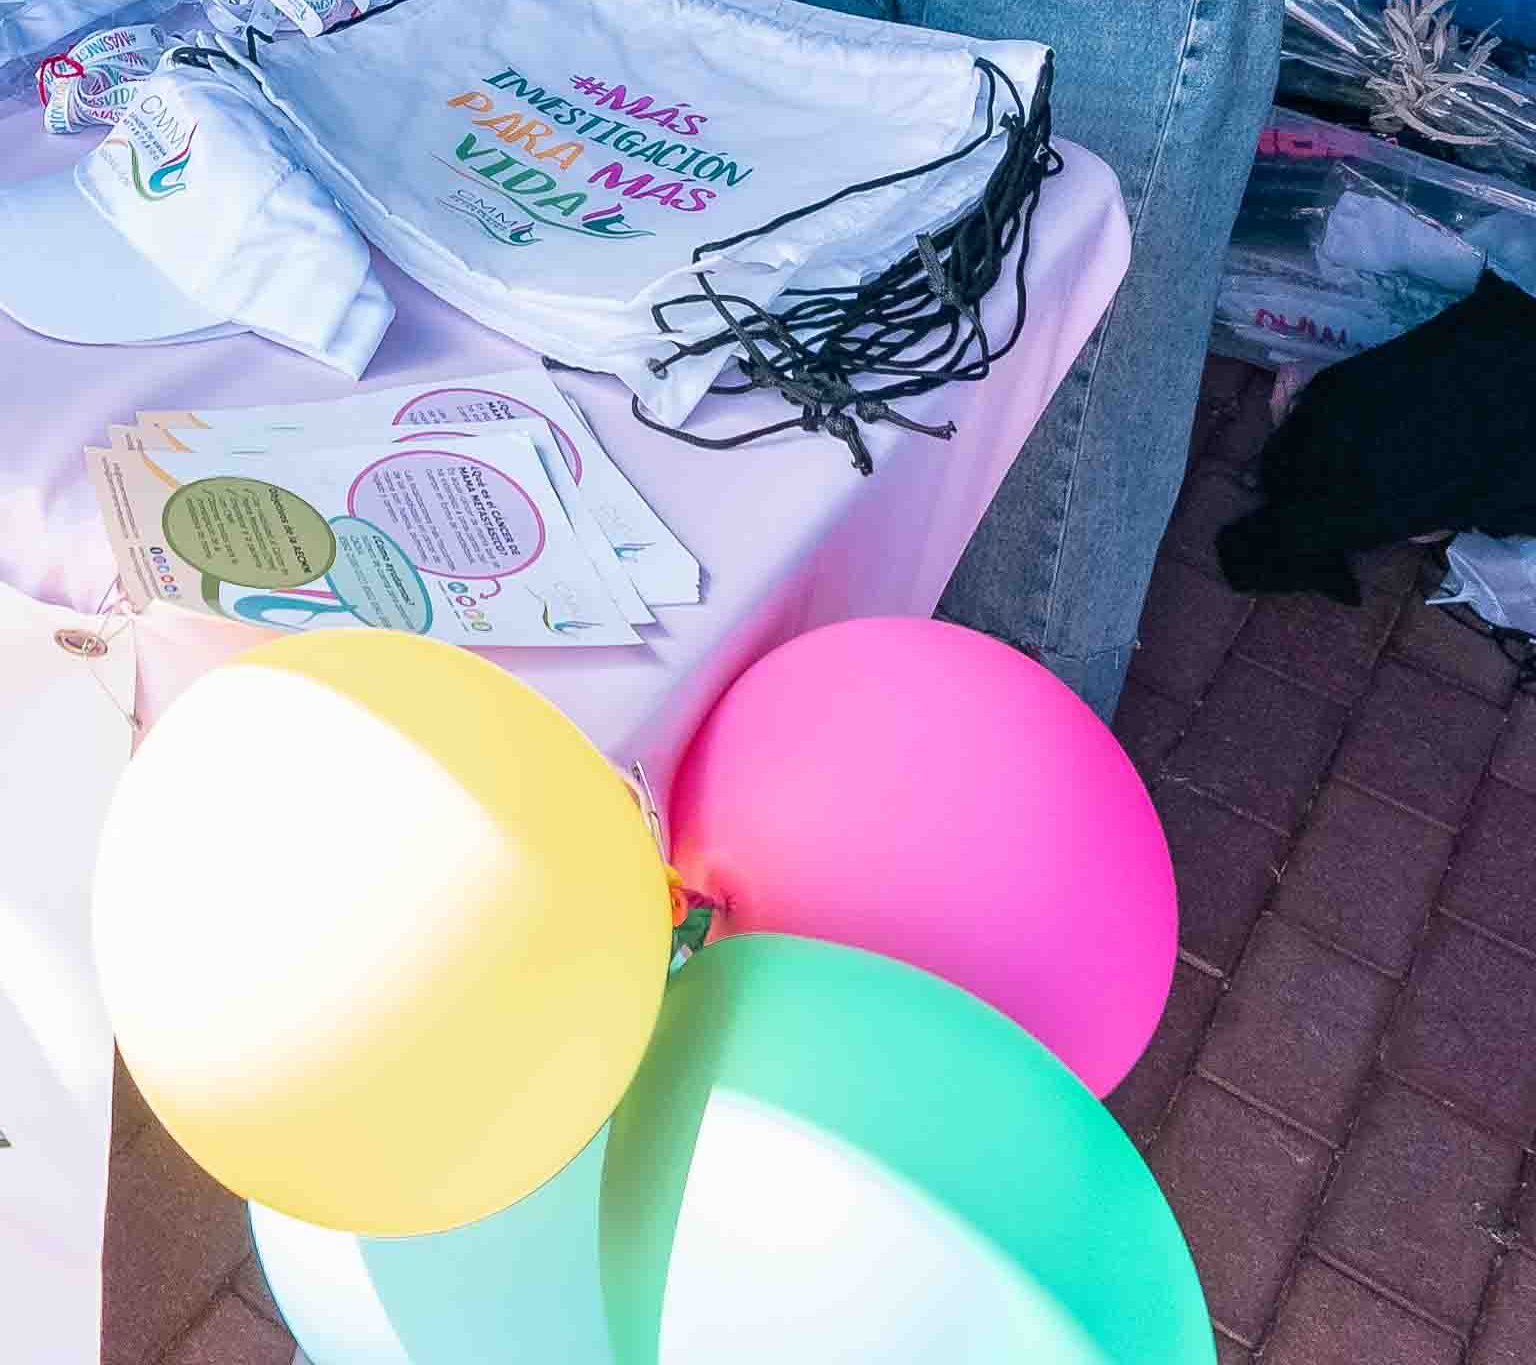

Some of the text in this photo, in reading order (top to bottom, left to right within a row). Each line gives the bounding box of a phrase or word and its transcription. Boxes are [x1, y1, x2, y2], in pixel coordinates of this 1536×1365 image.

[445, 90, 589, 173] PARA
[586, 161, 718, 213] MÁS
[481, 65, 753, 189] INVESTIGACIÓN
[568, 73, 710, 137] #MÁS
[453, 132, 590, 219] VIDA
